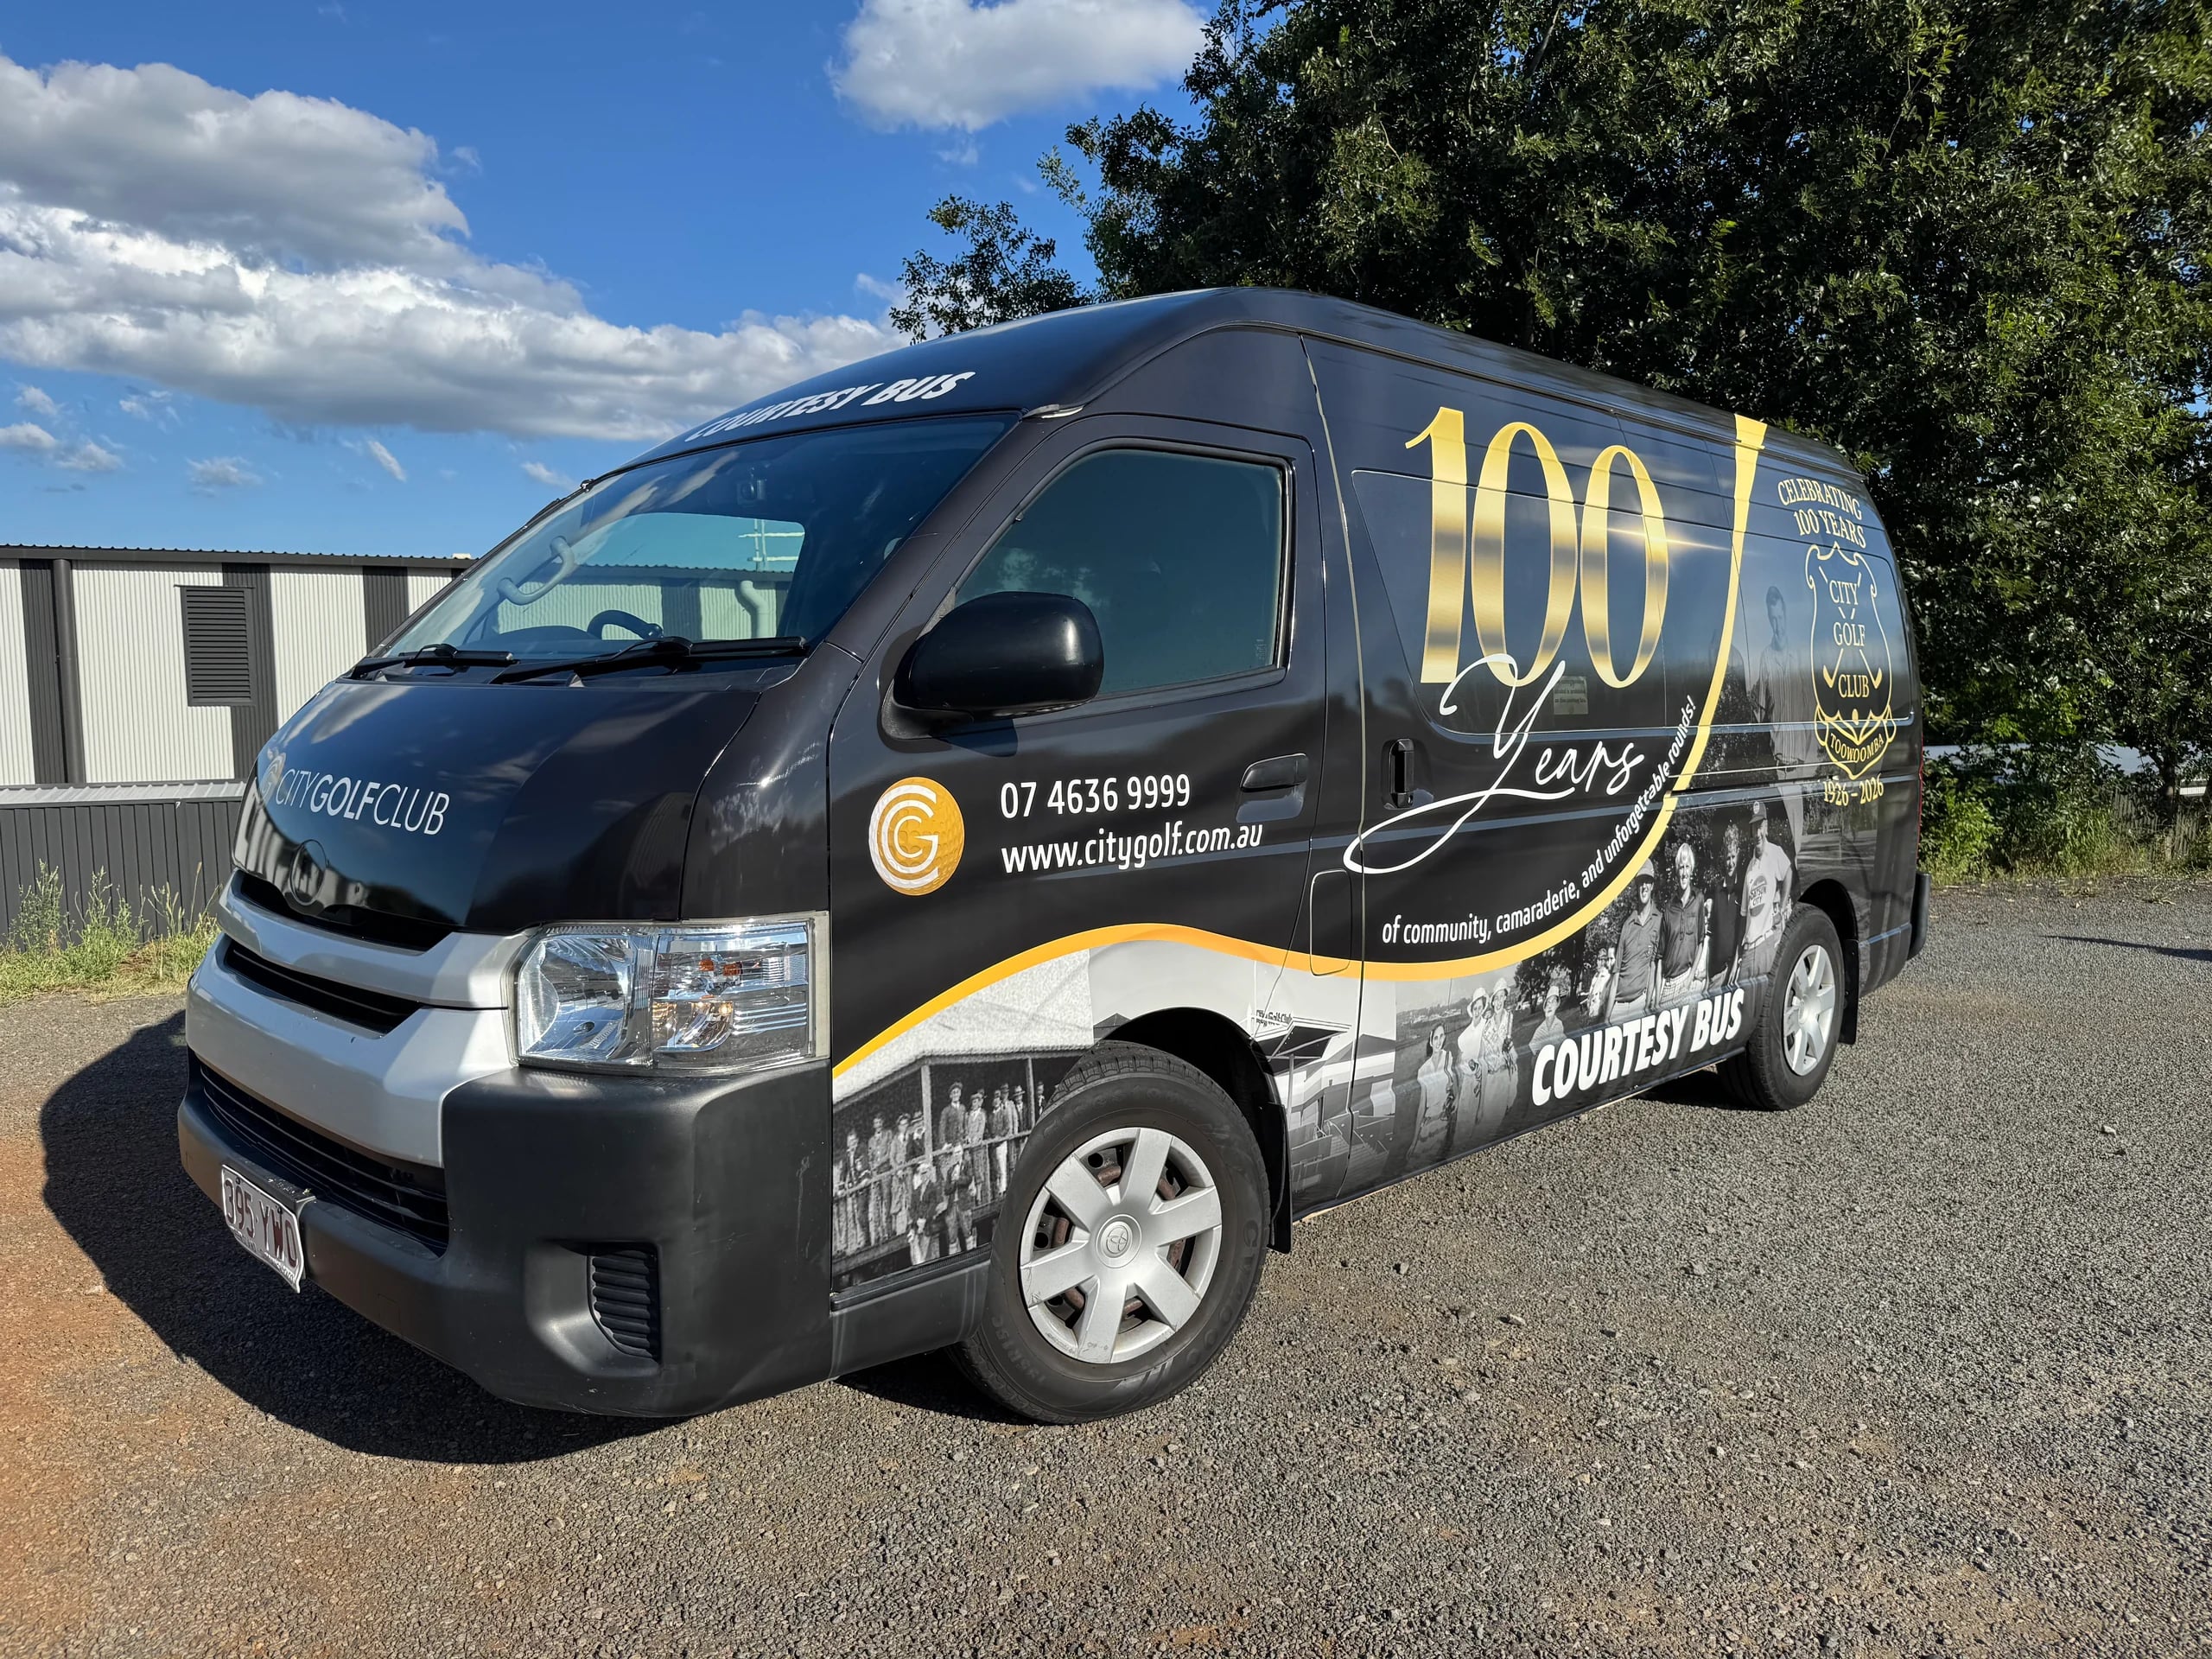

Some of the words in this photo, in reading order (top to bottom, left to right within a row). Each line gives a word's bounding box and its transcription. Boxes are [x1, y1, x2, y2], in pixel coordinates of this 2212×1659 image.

[685, 383, 884, 442] COURTESY
[861, 372, 976, 405] BUS
[1777, 478, 1862, 520] CELEBRATING
[1405, 406, 1669, 688] 100
[1793, 508, 1820, 536] 100
[1818, 510, 1866, 549] YEARS
[1829, 580, 1859, 605] CITY
[1834, 621, 1866, 646] GOLF
[1838, 674, 1870, 698] CLUB
[1344, 653, 1644, 874] Years
[1830, 733, 1884, 763] TOOWOOMBA
[1001, 781, 1038, 818] 07
[1047, 777, 1118, 815] 4636
[1127, 773, 1191, 810] 9999
[1859, 773, 1884, 804] 2026
[1382, 914, 1402, 944] of
[1403, 913, 1491, 944] community,
[1496, 880, 1580, 934] camaraderie,
[1582, 849, 1605, 888] and
[1605, 763, 1670, 864] unforgettable
[1668, 695, 1697, 766] rounds!
[1001, 820, 1263, 874] www.citygolf.com.au
[1532, 1004, 1689, 1106] COURTESY
[1690, 988, 1745, 1052] BUS
